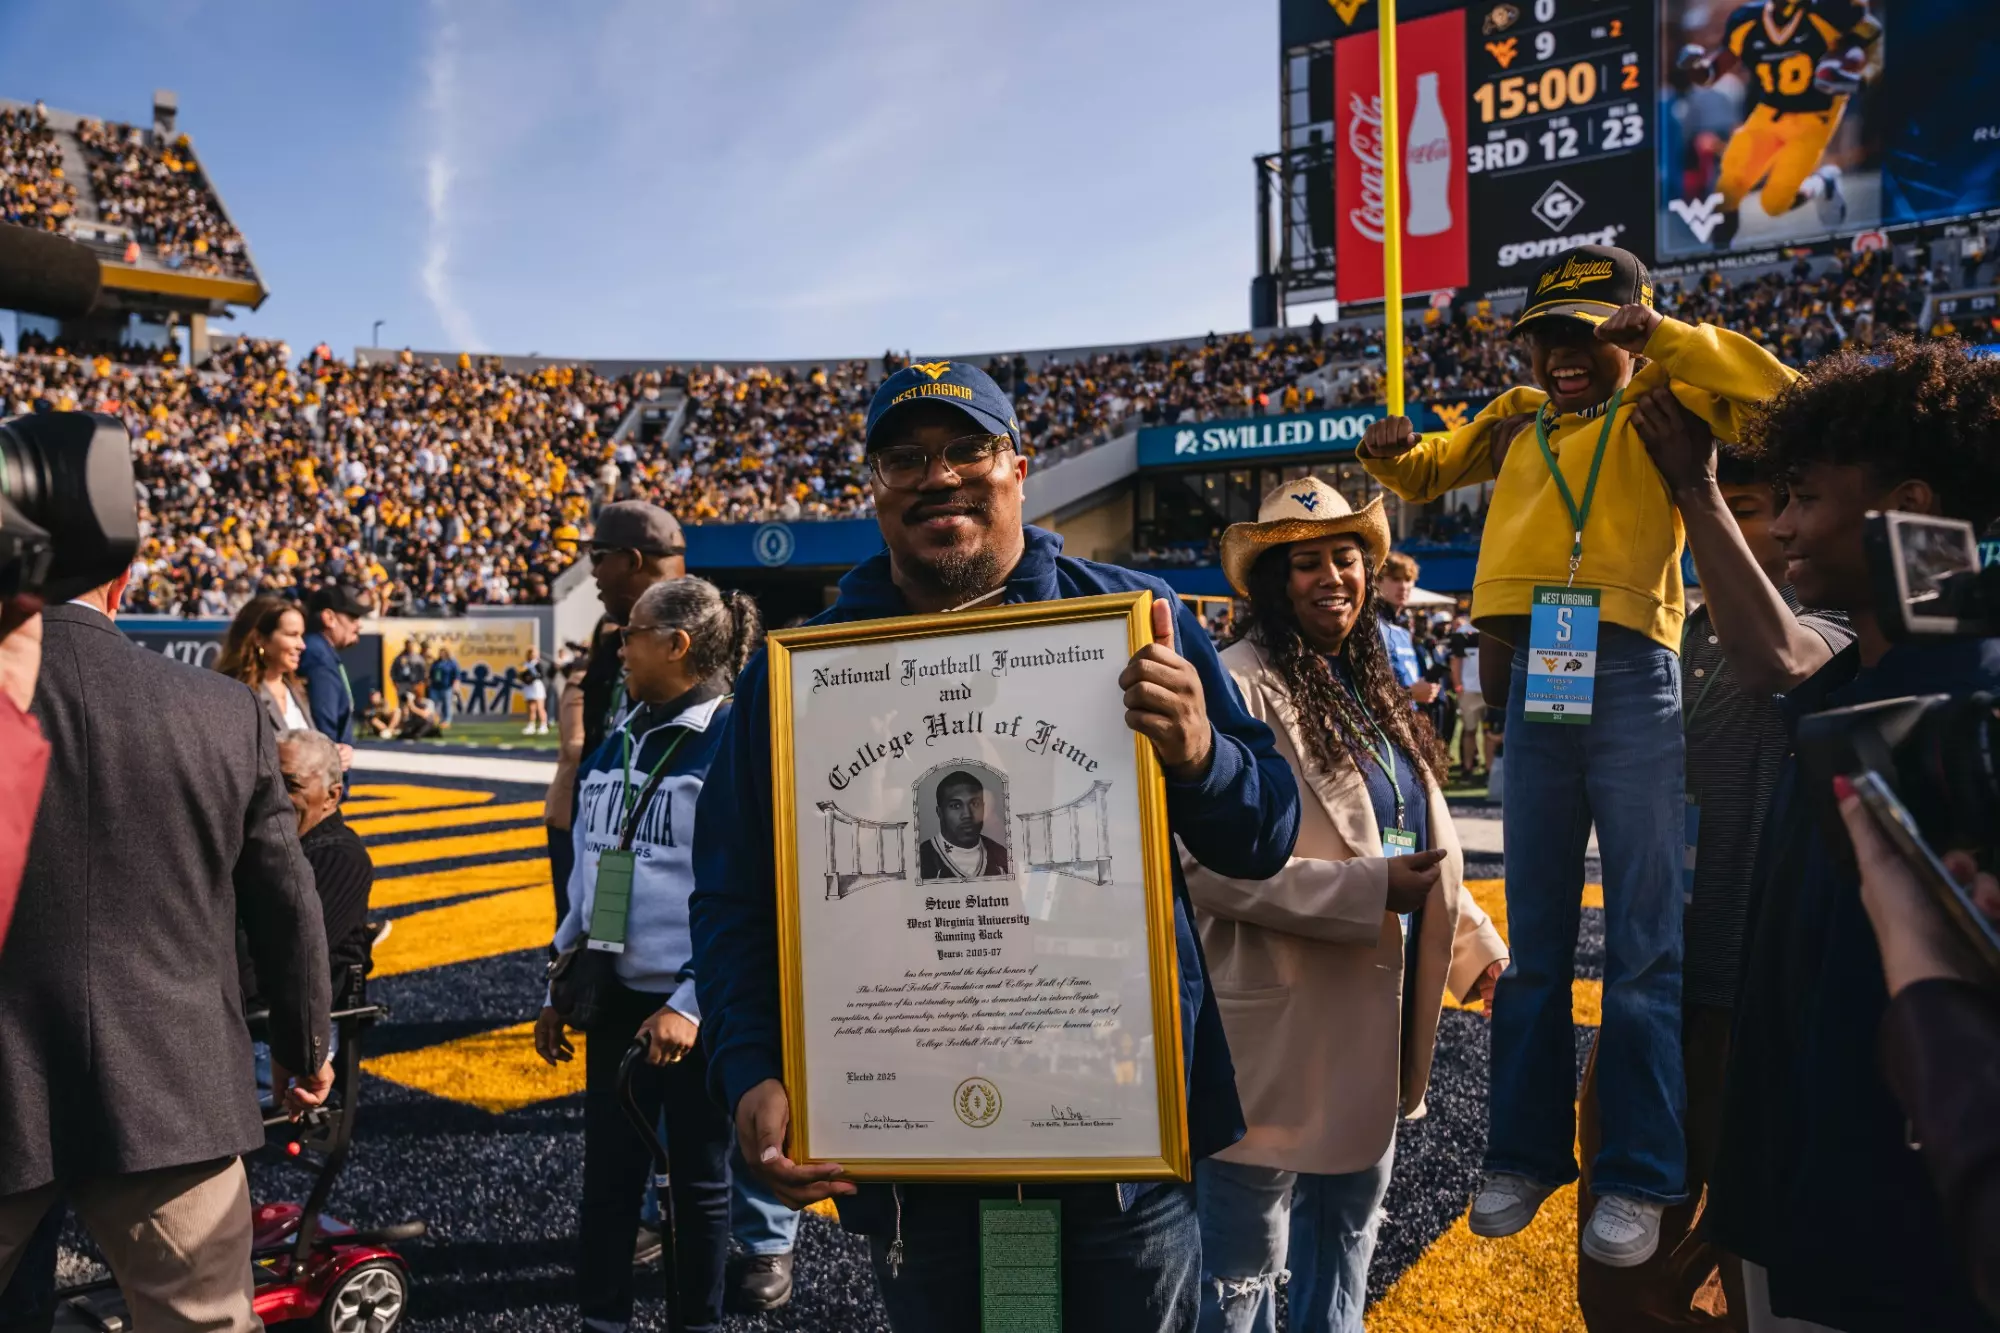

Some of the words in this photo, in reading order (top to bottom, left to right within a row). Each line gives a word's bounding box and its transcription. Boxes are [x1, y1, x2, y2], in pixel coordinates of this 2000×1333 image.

[1535, 32, 1555, 60] 9
[1621, 64, 1640, 91] 2
[1755, 53, 1813, 95] 10
[1473, 62, 1597, 123] 15:00
[1602, 115, 1644, 150] 23
[1539, 128, 1579, 161] 12
[1467, 138, 1529, 174] 3RD
[1497, 226, 1617, 267] gomart
[1561, 255, 1613, 281] Virginia
[920, 383, 973, 401] VIRGINIA
[1203, 420, 1314, 452] SWILLED
[1541, 592, 1560, 605] WEST
[1561, 593, 1593, 606] VIRGINIA
[1556, 607, 1573, 642] S
[1536, 649, 1567, 657] NOVEMBER
[813, 663, 892, 694] National
[901, 653, 981, 687] Football
[991, 646, 1105, 677] Foundation
[939, 683, 972, 702] and
[1552, 703, 1565, 711] 423
[828, 731, 915, 791] College
[923, 711, 984, 747] Hall
[994, 716, 1023, 738] of
[1025, 719, 1099, 773] Fame
[925, 896, 961, 911] Steve
[965, 895, 1009, 909] Slaton
[907, 918, 932, 929] West
[934, 917, 975, 929] Virginia
[978, 914, 1030, 926] University
[934, 931, 976, 942] Running
[978, 929, 1004, 940] Back
[937, 949, 964, 960] Years:
[966, 948, 1002, 958] 2005-07
[904, 969, 917, 978] has
[918, 968, 933, 977] been
[934, 967, 963, 979] granted
[963, 966, 975, 976] the
[975, 965, 1001, 978] highest
[1002, 966, 1026, 975] honors
[1028, 964, 1039, 976] of
[856, 984, 871, 994] The
[871, 983, 907, 993] National
[906, 982, 942, 993] Football
[942, 978, 984, 991] Foundation
[985, 979, 1003, 990] and
[1005, 978, 1033, 990] College
[1035, 977, 1059, 988] Hall
[1057, 976, 1069, 988] of
[855, 1000, 896, 1009] recognition
[894, 998, 904, 1009] of
[903, 998, 913, 1006] his
[914, 997, 955, 1007] outstanding
[957, 995, 980, 1006] ability
[991, 994, 1040, 1004] demonstrated
[1049, 992, 1100, 1002] intercollegiate
[873, 1012, 883, 1020] his
[1009, 1008, 1026, 1017] and
[1025, 1007, 1068, 1016] contribution
[1068, 1006, 1076, 1015] to
[1078, 1004, 1089, 1014] the
[1091, 1005, 1111, 1016] sport
[1111, 1004, 1122, 1015] of
[864, 1025, 877, 1034] this
[878, 1025, 912, 1036] certificate
[912, 1024, 931, 1033] bears
[931, 1024, 957, 1032] witness
[958, 1023, 974, 1032] that
[974, 1023, 986, 1031] his
[986, 1023, 1006, 1031] name
[1008, 1021, 1027, 1030] shall
[1027, 1021, 1036, 1030] be
[1062, 1020, 1093, 1029] honored
[916, 1038, 944, 1049] College
[945, 1036, 979, 1048] Football
[980, 1036, 1001, 1046] Hall
[1000, 1036, 1012, 1048] of
[1010, 1036, 1033, 1046] Fame
[846, 1071, 874, 1085] Elected
[876, 1072, 897, 1081] 2025
